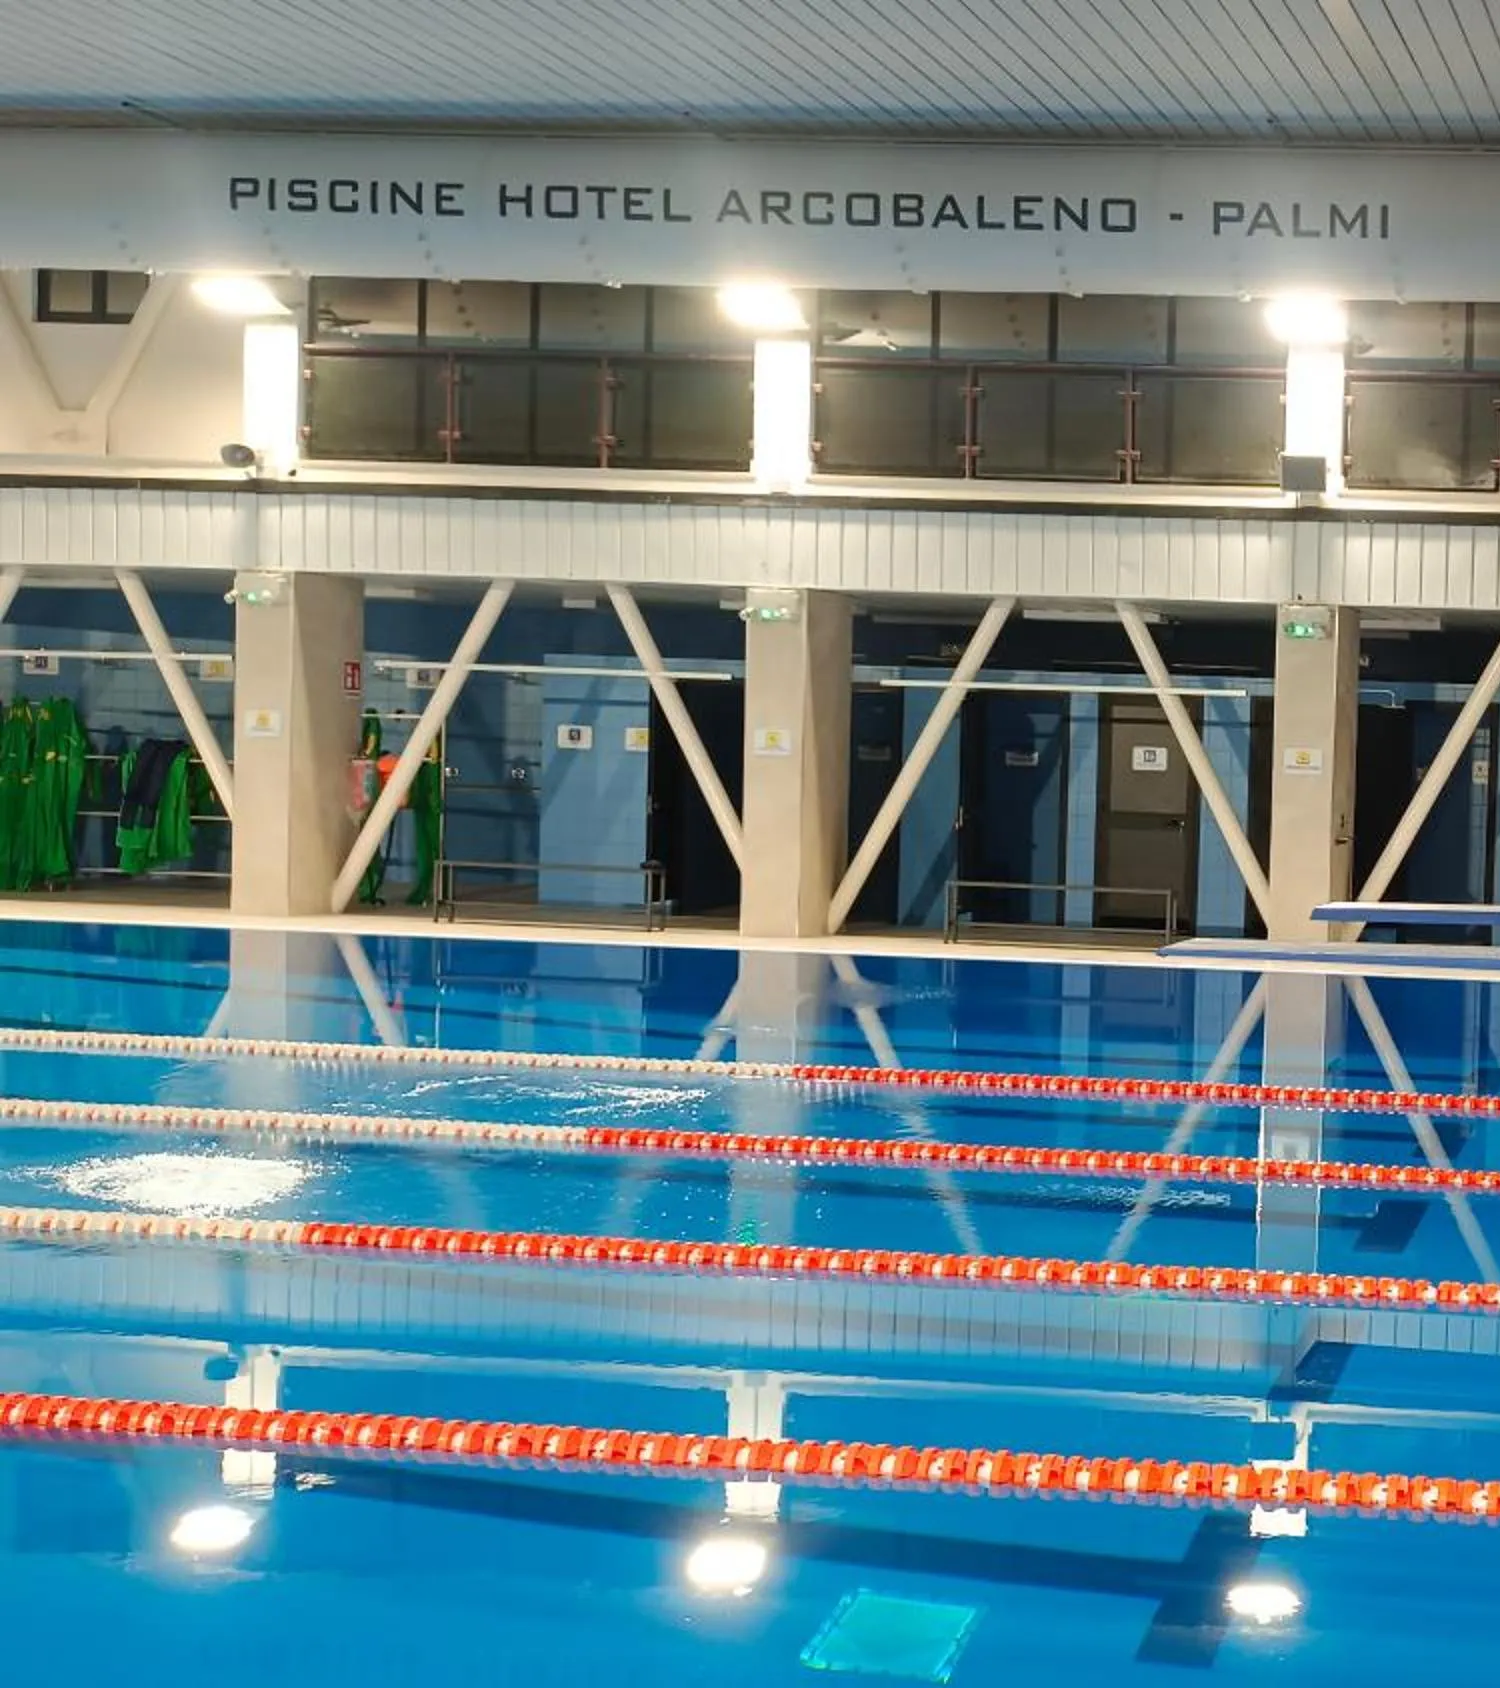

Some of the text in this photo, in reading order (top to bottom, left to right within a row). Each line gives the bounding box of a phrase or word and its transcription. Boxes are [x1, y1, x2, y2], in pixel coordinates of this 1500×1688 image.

[229, 176, 466, 217] PISCINE
[499, 183, 692, 223] HOTEL
[715, 188, 1138, 233] ARCOBALENO
[1211, 200, 1391, 240] PALMI
